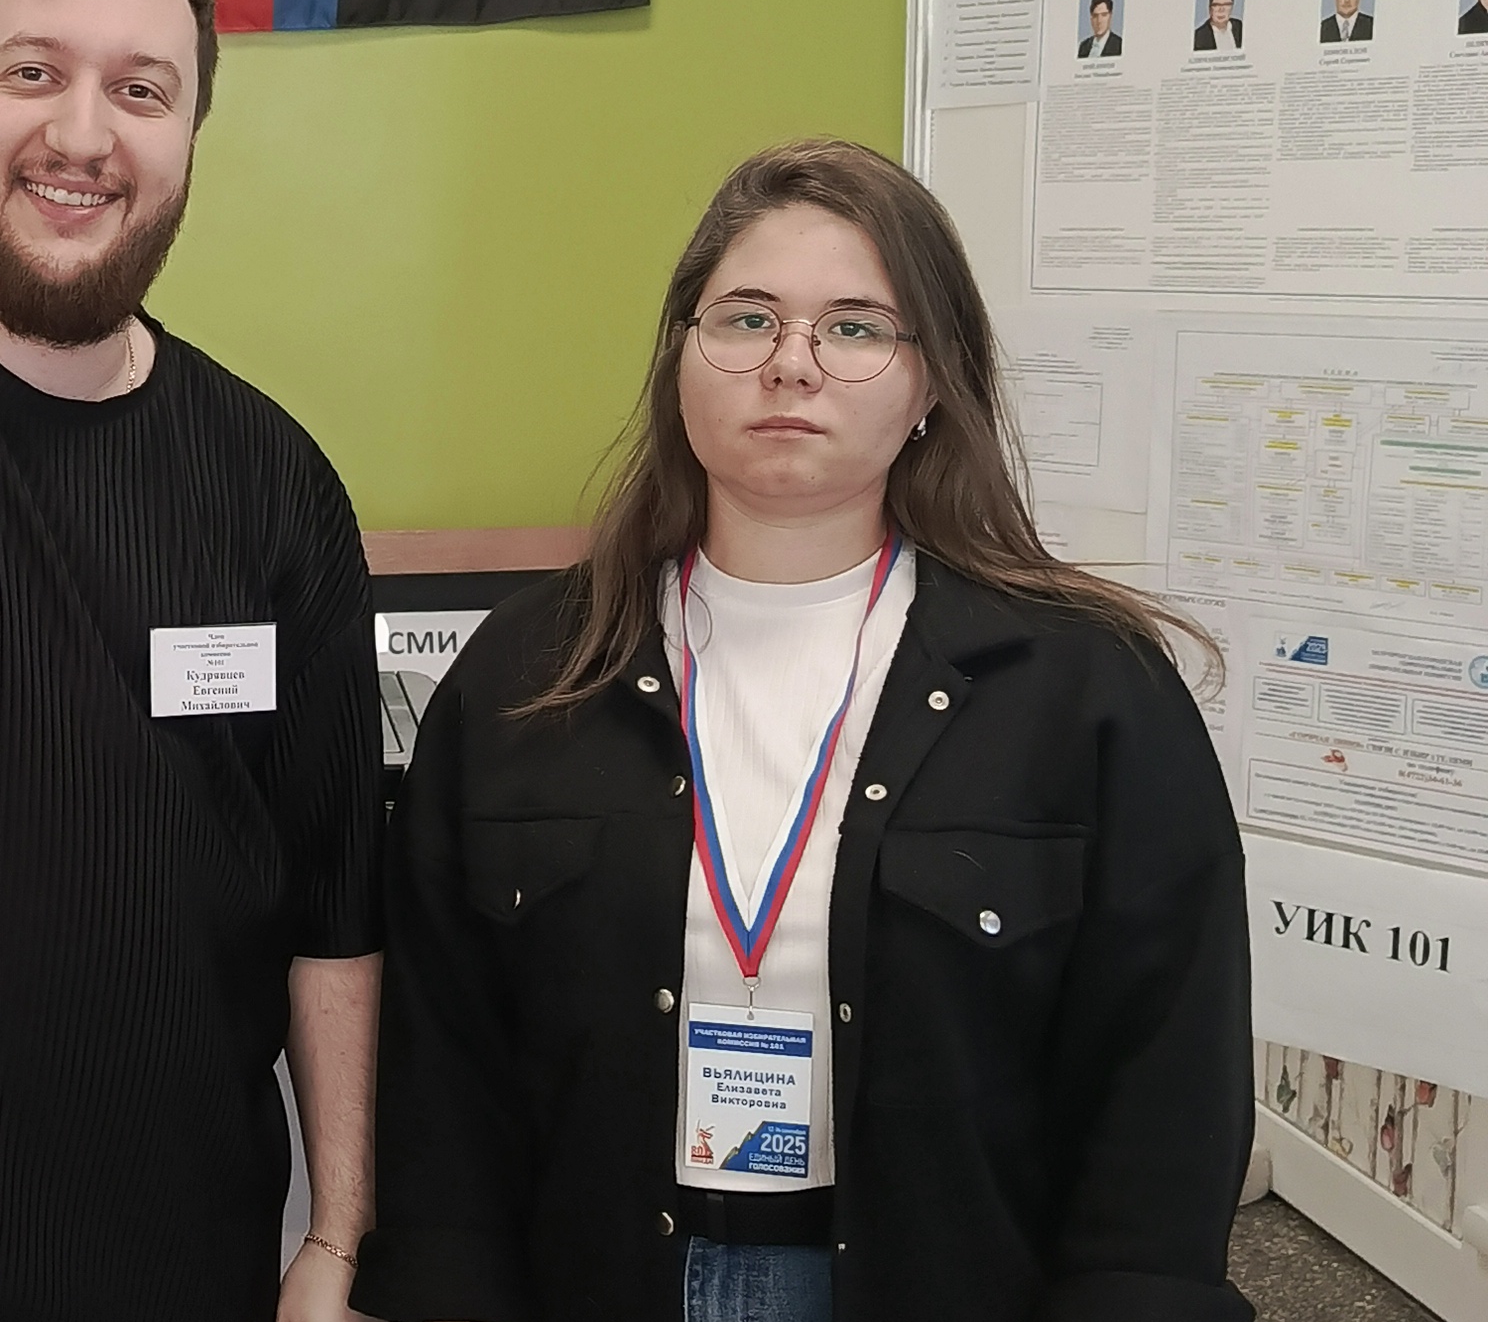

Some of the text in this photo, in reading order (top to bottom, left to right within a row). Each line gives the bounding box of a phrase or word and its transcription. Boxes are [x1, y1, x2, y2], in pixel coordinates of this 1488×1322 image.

[388, 630, 458, 655] СМИ
[186, 670, 245, 683] Кудрявцев
[193, 684, 238, 696] Евгений
[181, 700, 250, 711] Михайлович
[1269, 899, 1451, 974] УИК 101
[694, 1028, 807, 1044] УЧАСТКОВАЯ ИЗБИРАТЕЛЬНАЯ
[716, 1039, 760, 1048] КОМИССИЯ
[769, 1042, 785, 1050] 101
[702, 1067, 796, 1086] ВЬЯЛИЦИНА
[716, 1082, 782, 1097] Елизавета
[711, 1094, 787, 1109] Викторовна
[760, 1133, 806, 1155] 2025
[748, 1152, 806, 1167] ЕДИНЫЙ ДЕНЬ
